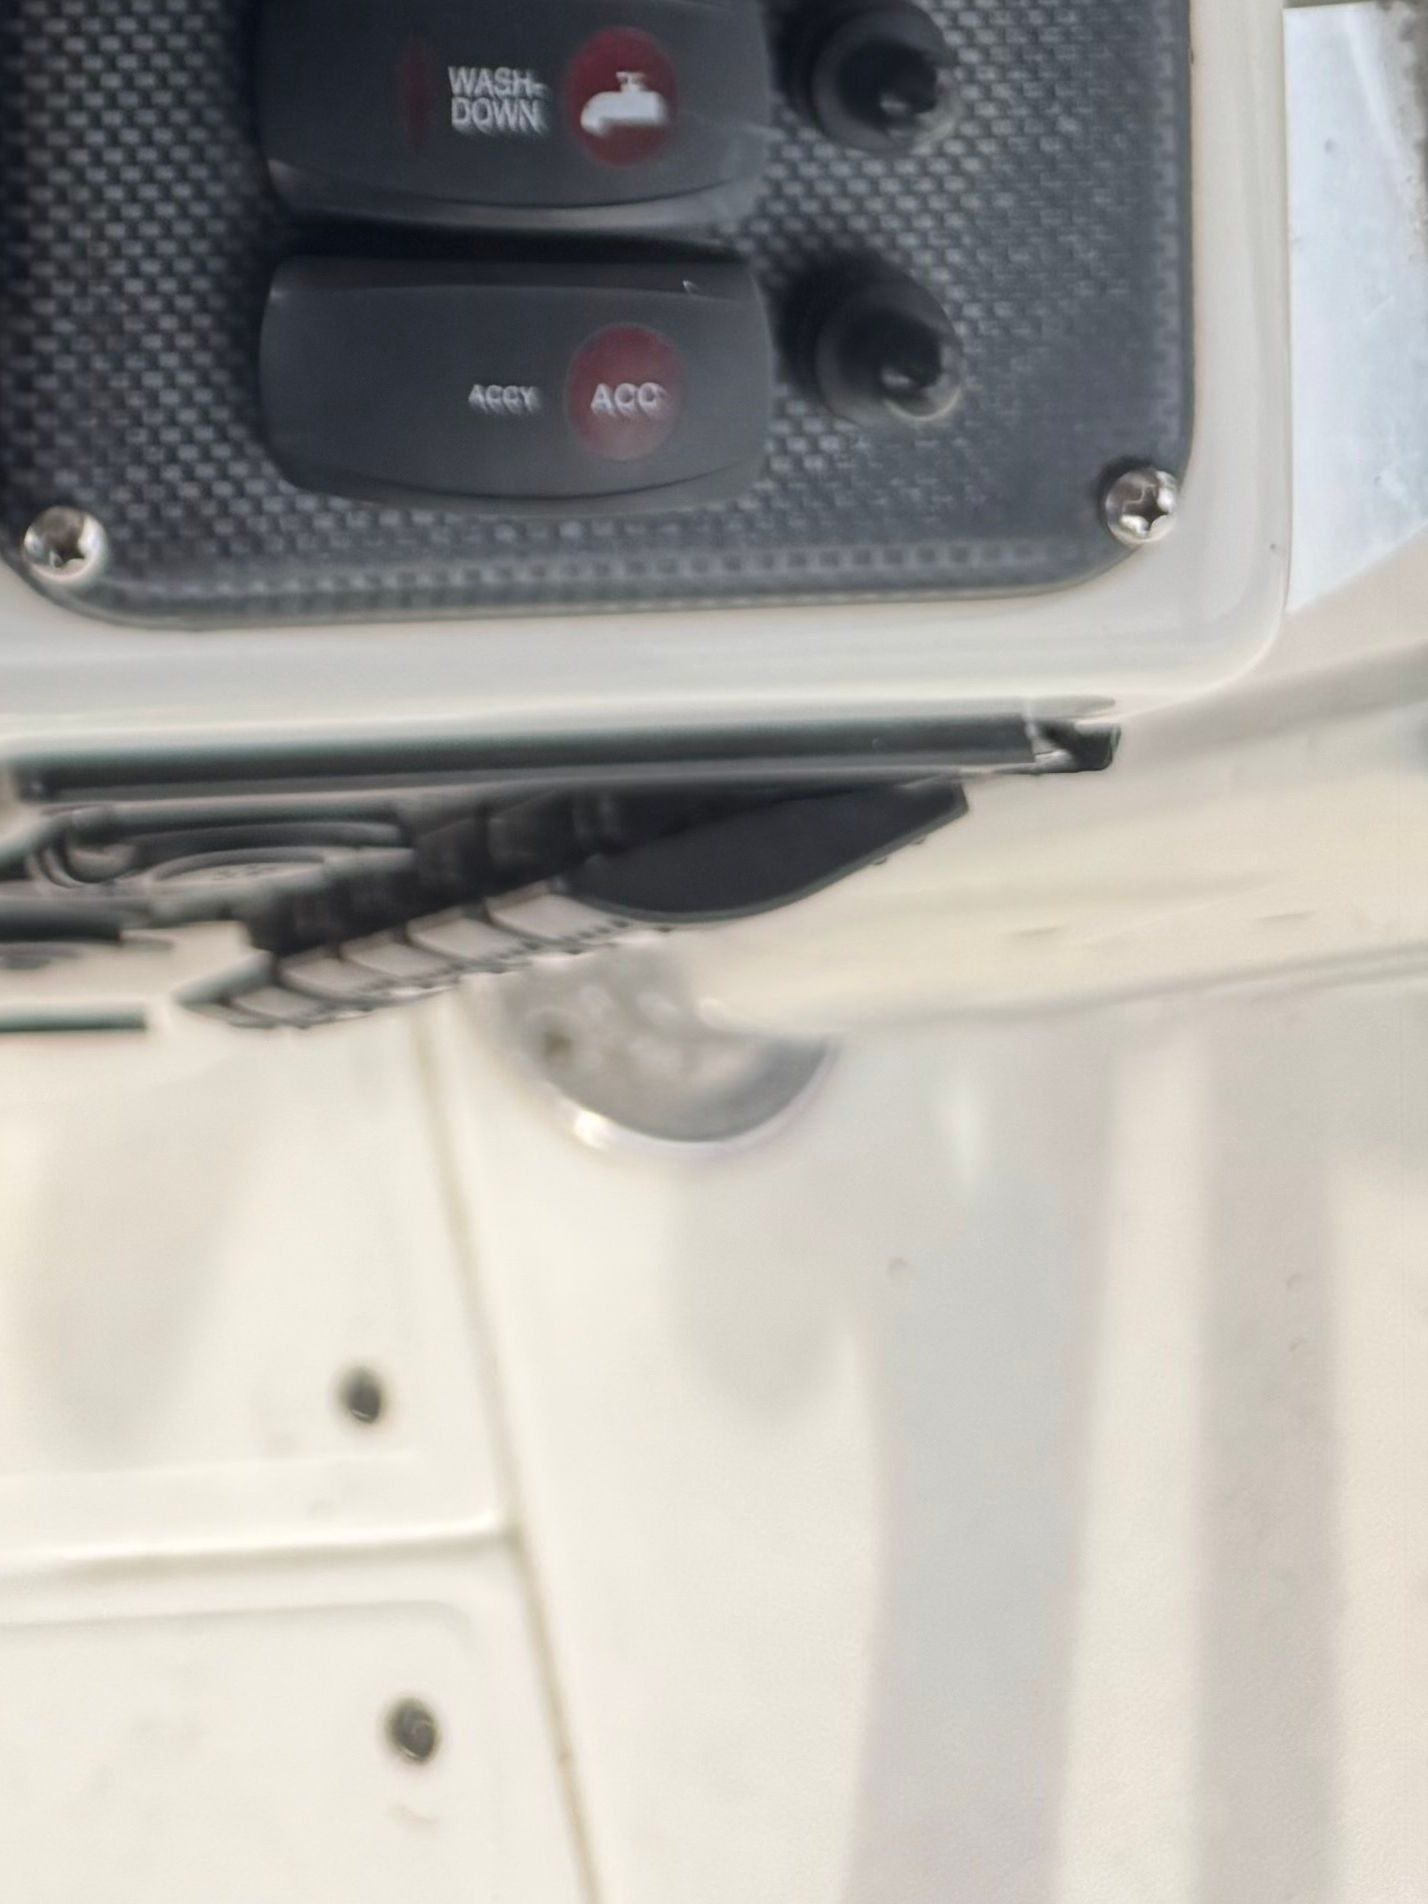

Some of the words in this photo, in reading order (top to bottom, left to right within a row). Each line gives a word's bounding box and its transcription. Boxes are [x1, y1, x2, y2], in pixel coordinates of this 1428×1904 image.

[448, 66, 546, 100] WASH-
[450, 98, 546, 134] DOWN
[469, 384, 540, 414] ACCY
[591, 382, 664, 416] ACC
